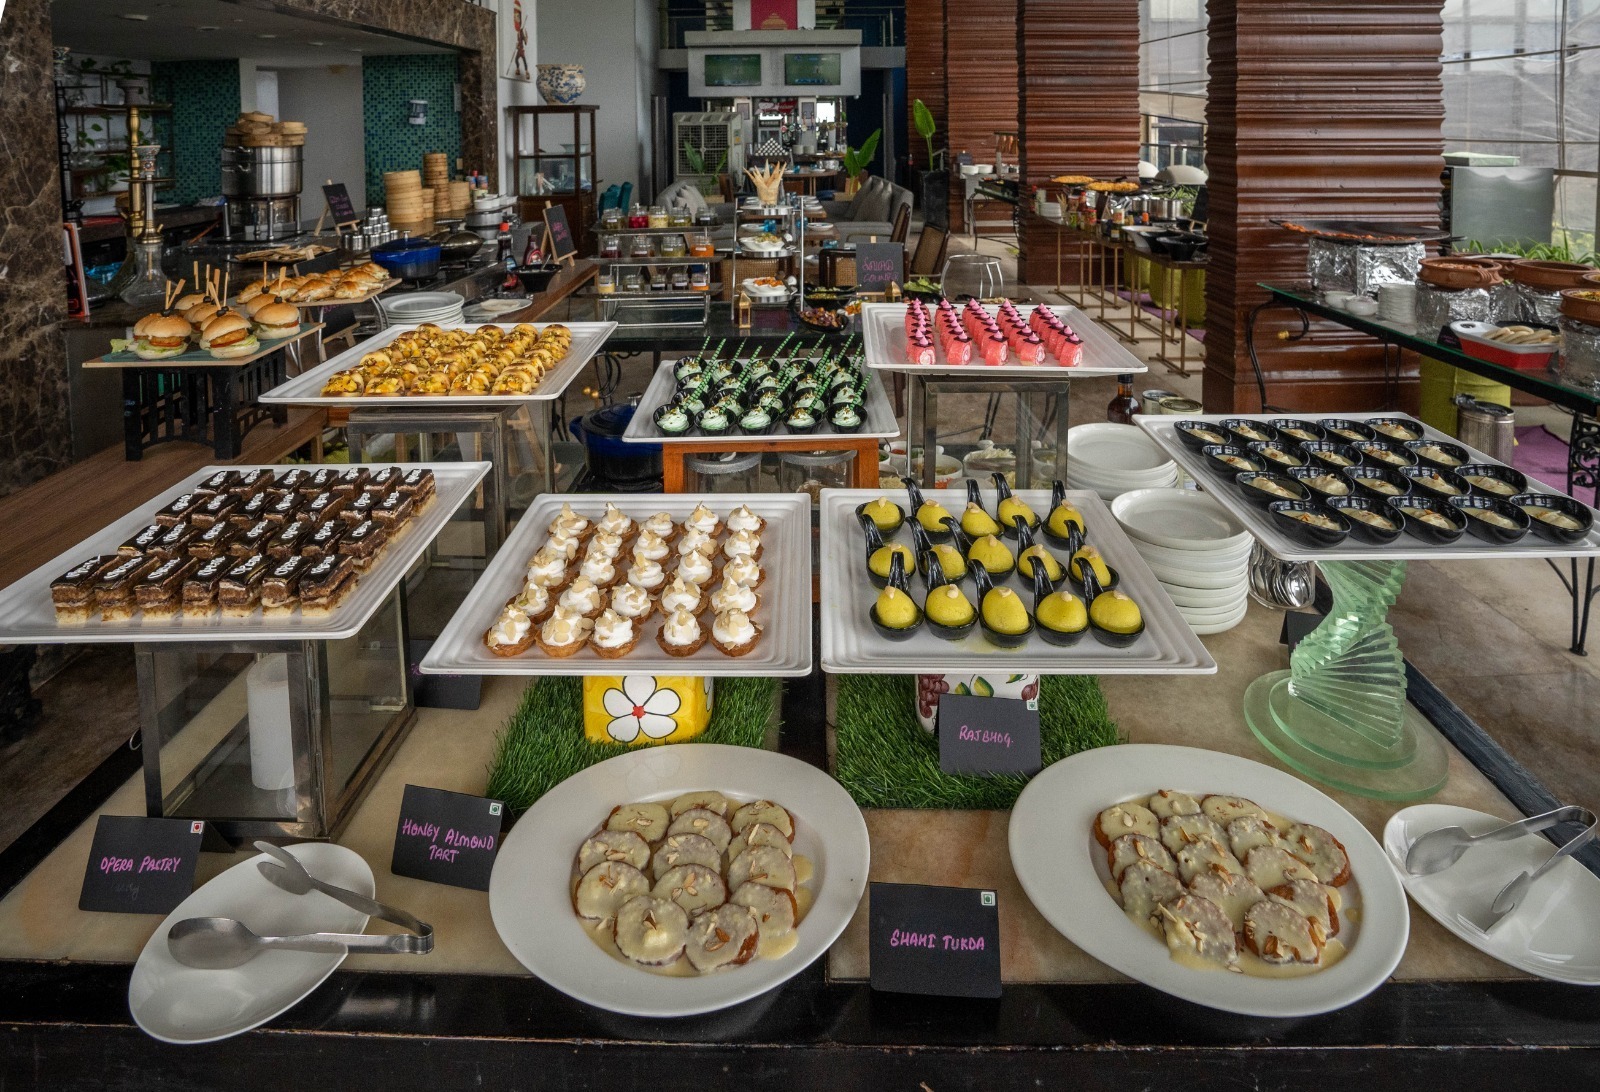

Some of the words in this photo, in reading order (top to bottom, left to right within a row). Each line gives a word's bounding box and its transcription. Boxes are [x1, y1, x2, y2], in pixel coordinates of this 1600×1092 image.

[402, 818, 440, 843] HONEY
[444, 828, 494, 850] ALMOND
[429, 844, 460, 863] TART
[101, 856, 134, 874] OPERA
[138, 855, 181, 874] PASTRY
[890, 928, 936, 949] SHAHI
[942, 935, 985, 951] TUKDA
